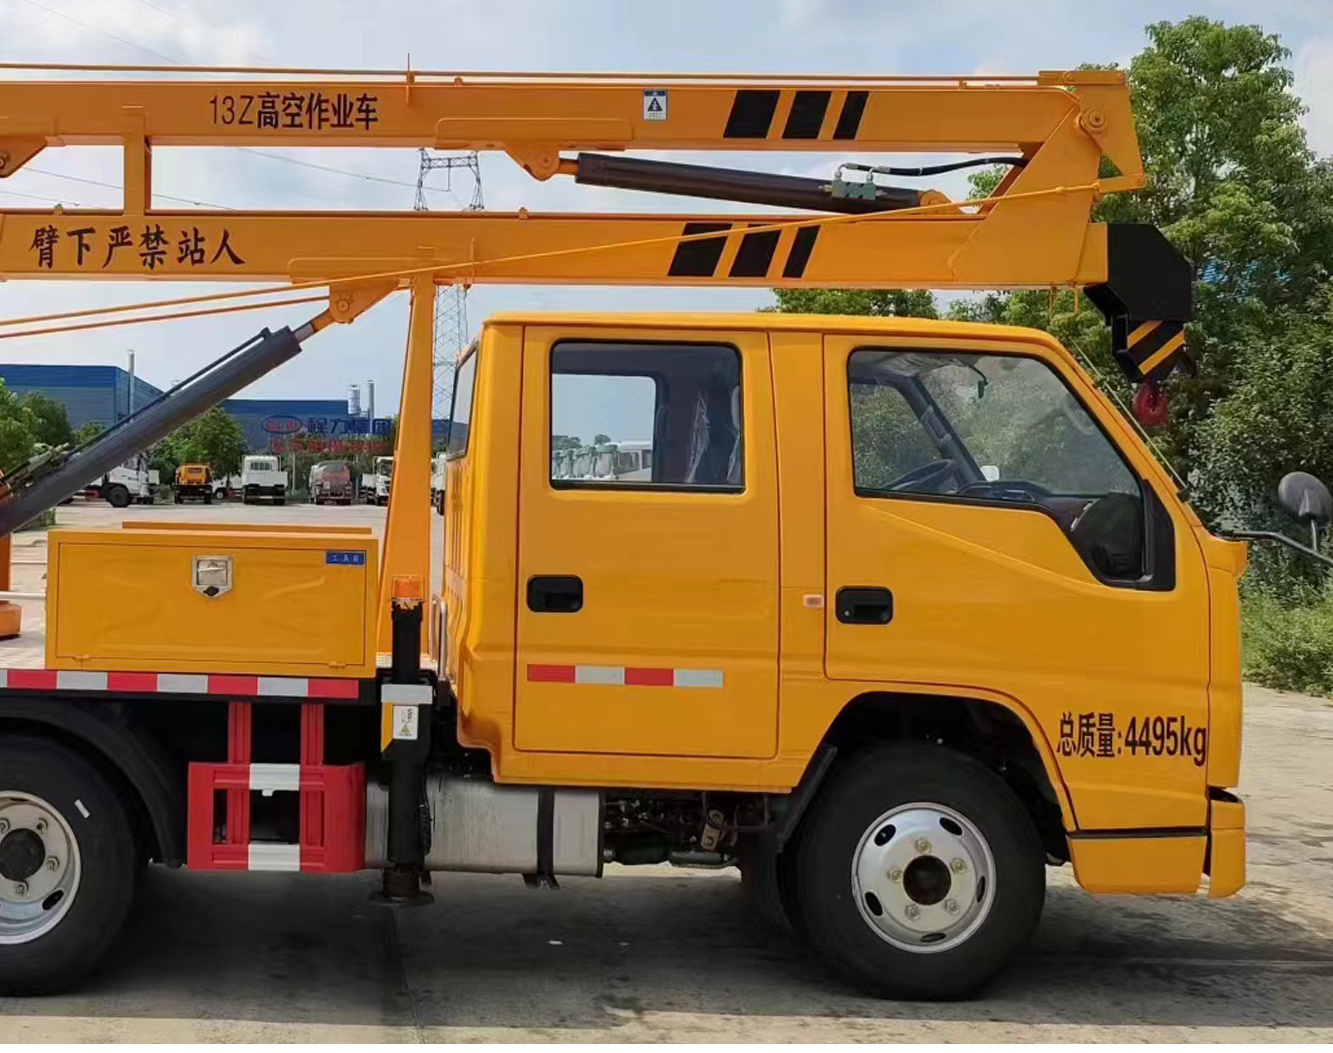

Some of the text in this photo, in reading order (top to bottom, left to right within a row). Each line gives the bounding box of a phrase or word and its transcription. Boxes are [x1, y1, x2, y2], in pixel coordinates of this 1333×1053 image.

[209, 91, 379, 131] 13Z高空作业车
[28, 223, 246, 270] 臂下严禁站人
[1056, 711, 1207, 766] 总质量:4495kg
